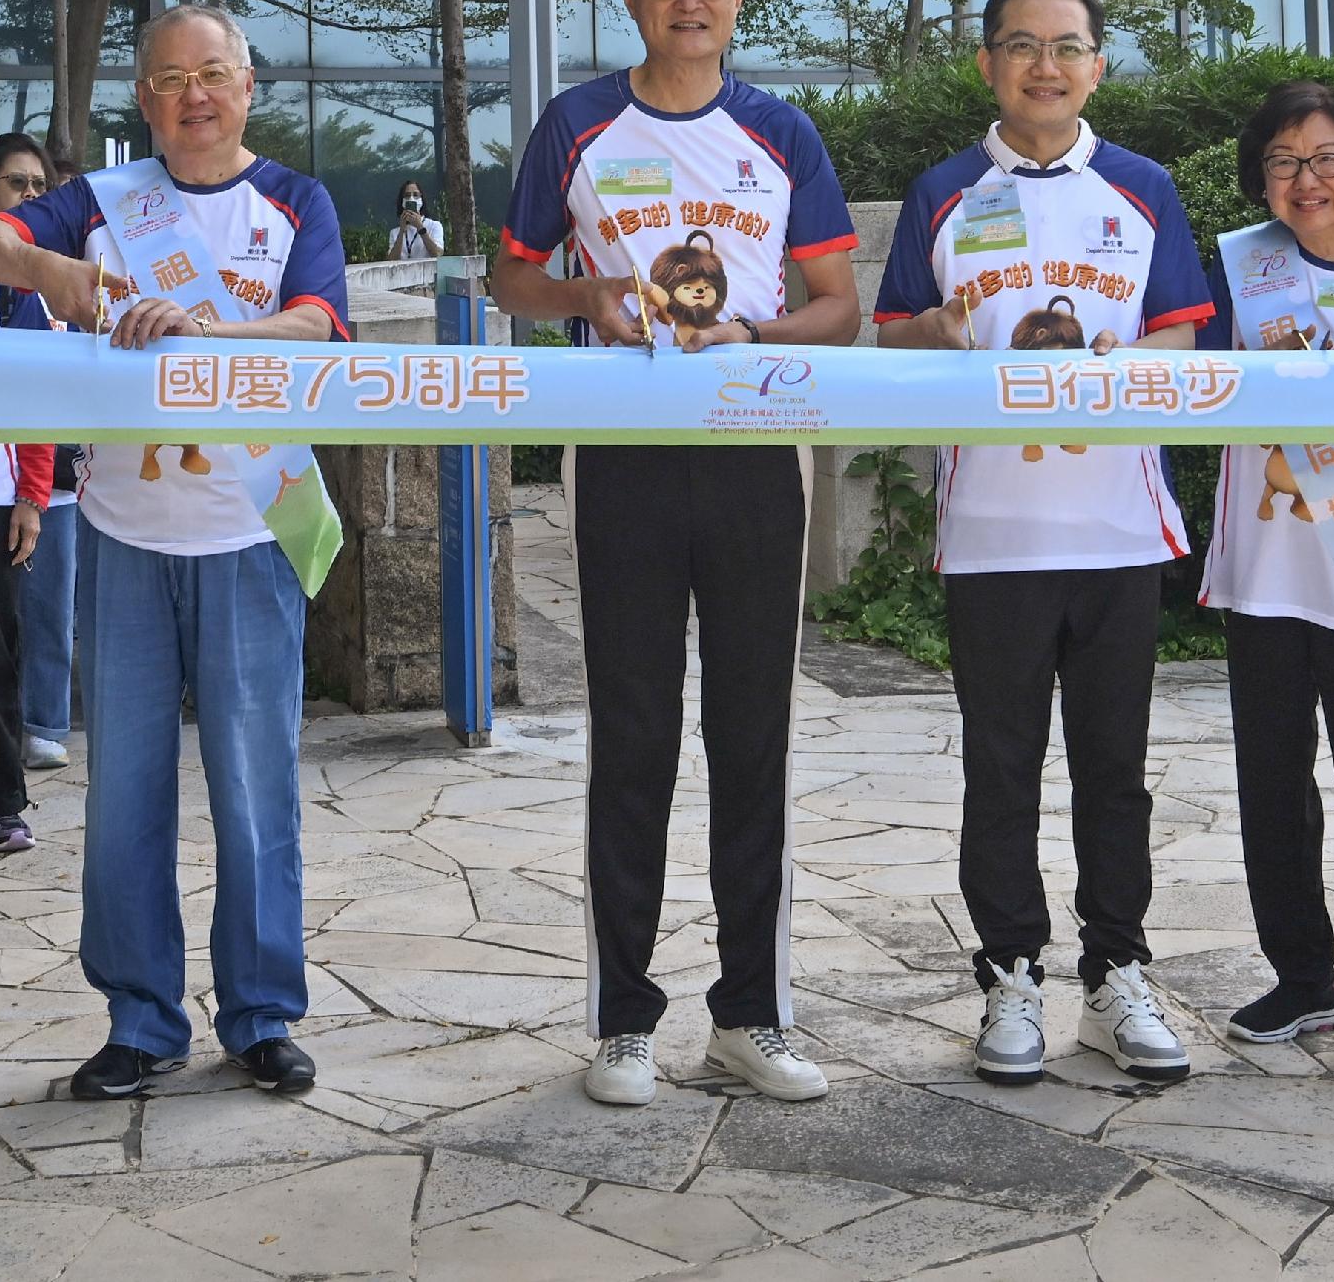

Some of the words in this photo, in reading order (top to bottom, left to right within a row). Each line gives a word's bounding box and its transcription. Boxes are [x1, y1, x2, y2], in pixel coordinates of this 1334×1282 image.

[158, 354, 528, 411] 國慶75周年
[757, 351, 811, 396] 75
[998, 361, 1241, 410] 日行萬步
